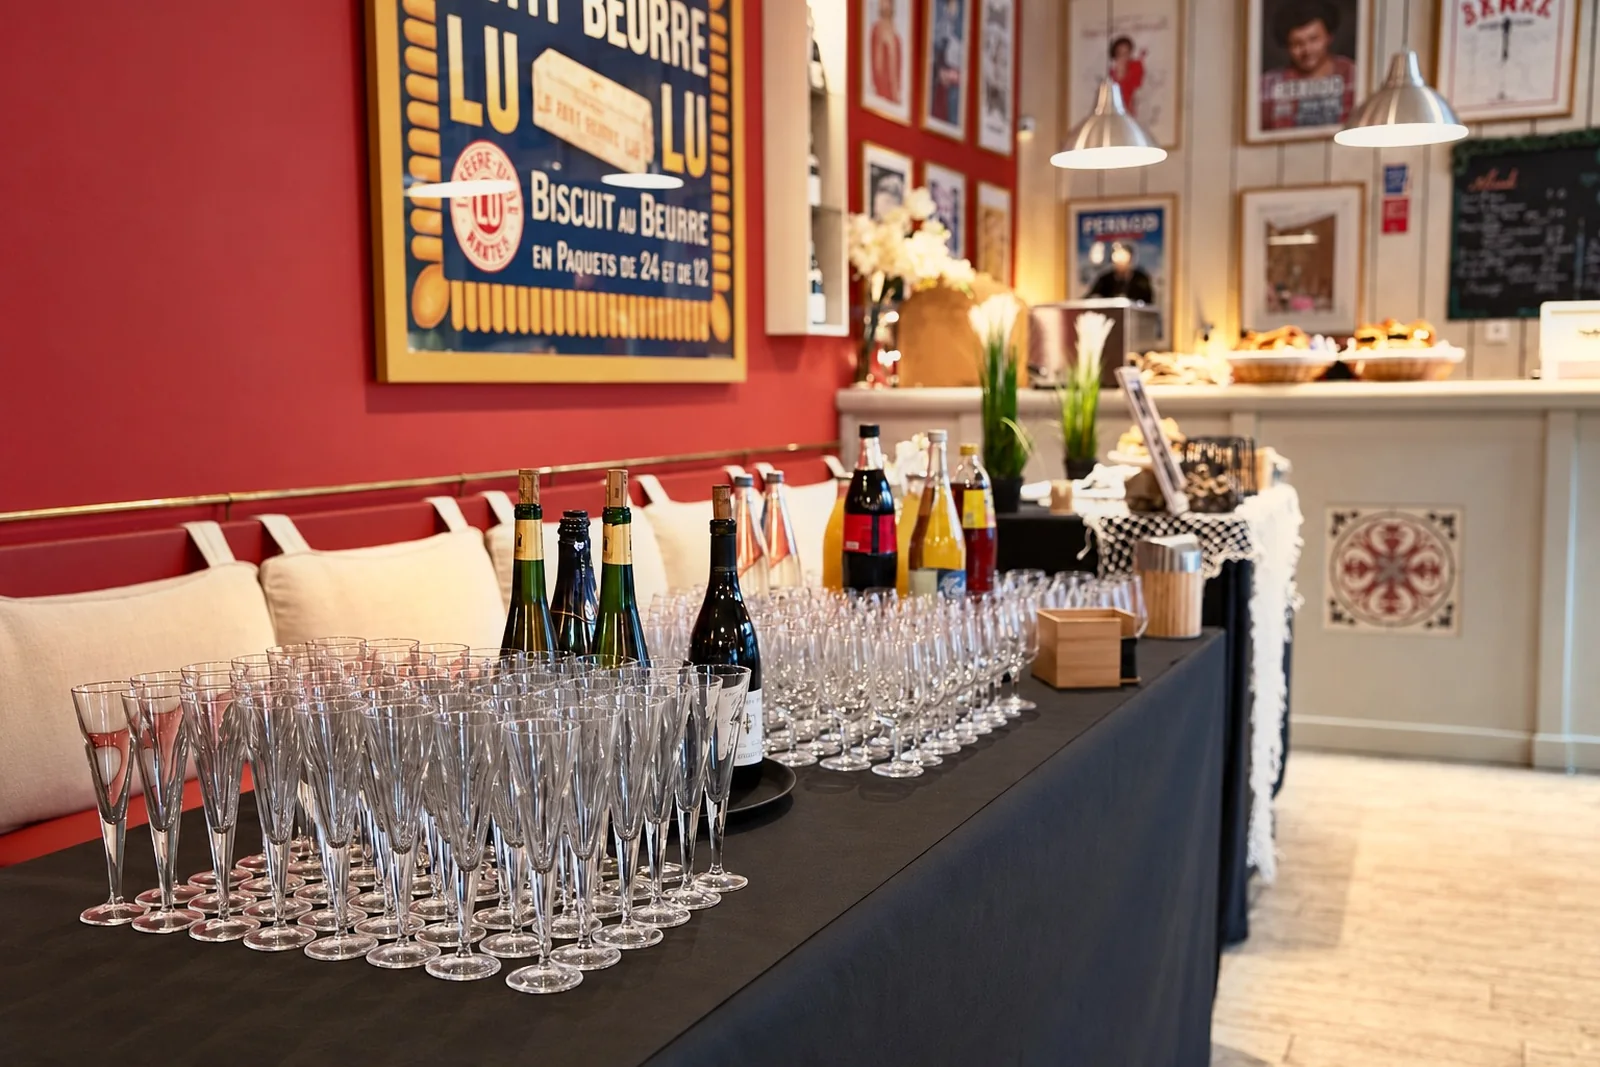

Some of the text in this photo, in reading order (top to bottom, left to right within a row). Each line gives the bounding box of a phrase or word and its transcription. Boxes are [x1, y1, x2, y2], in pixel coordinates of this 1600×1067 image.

[447, 14, 519, 135] LU
[661, 83, 708, 178] LU
[531, 170, 616, 230] BISCUIT
[640, 192, 709, 246] BEURRE
[1082, 212, 1159, 234] PERNOD
[532, 240, 709, 287] EN PAQUETS DE 24 ET DE 12
